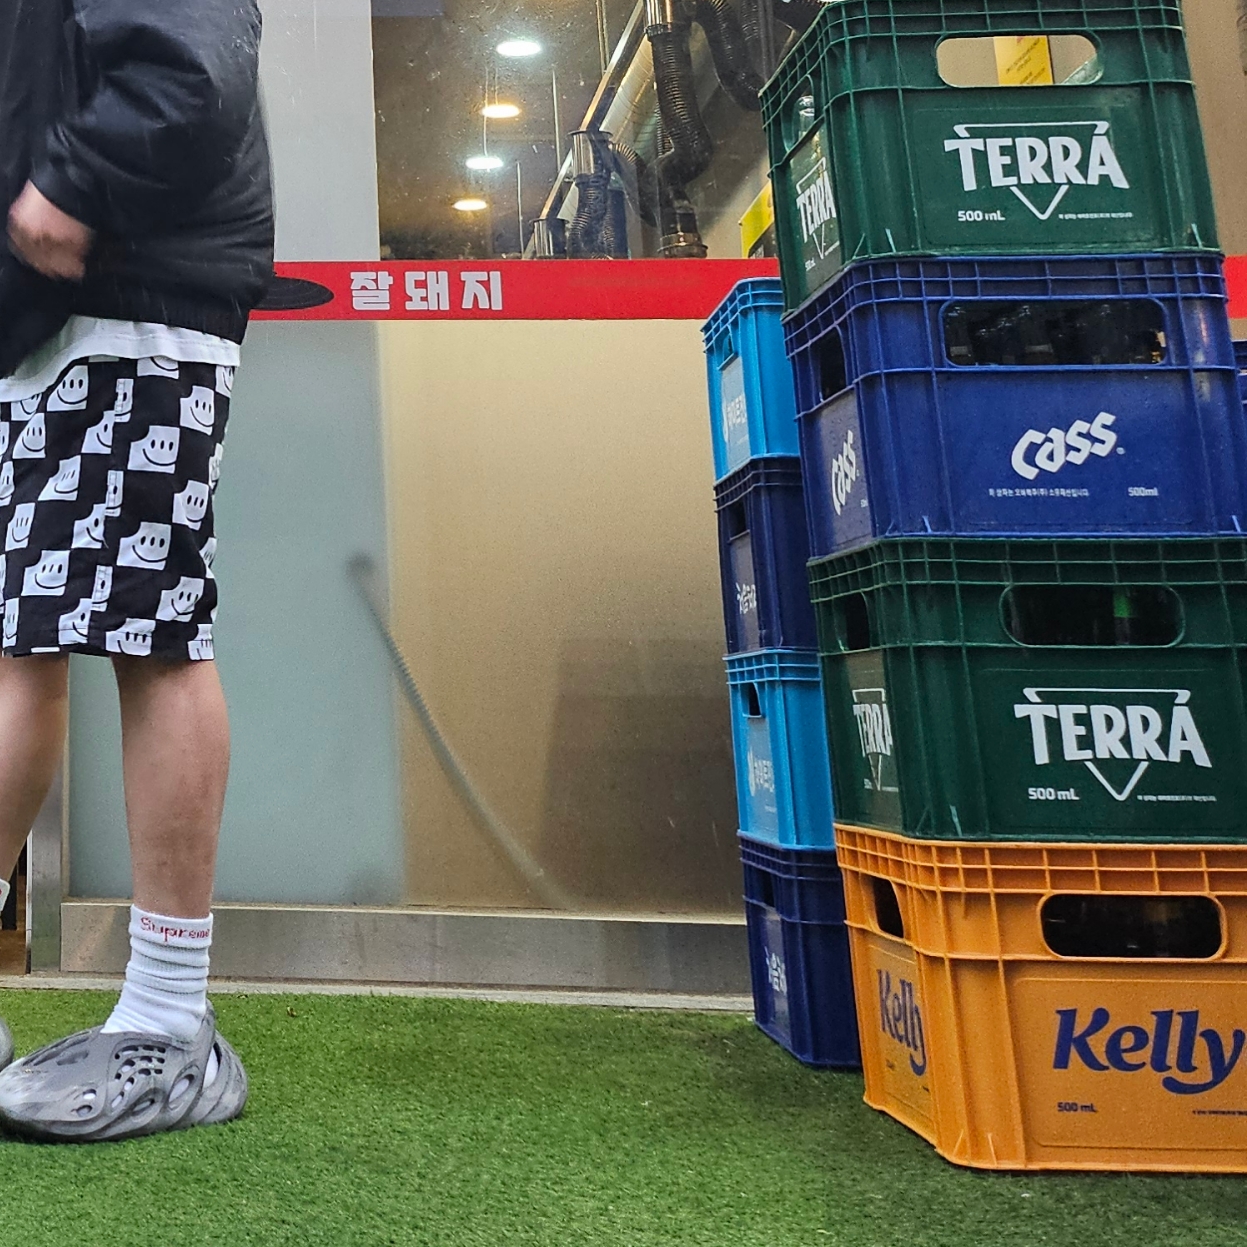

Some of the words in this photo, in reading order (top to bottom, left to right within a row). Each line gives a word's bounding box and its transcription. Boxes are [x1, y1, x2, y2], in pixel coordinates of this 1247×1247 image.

[944, 131, 1130, 192] TERRA
[796, 170, 837, 244] TERRA
[852, 703, 894, 758] TERRA
[1014, 696, 1212, 768] TERRA
[876, 968, 927, 1077] Kelly
[1053, 1006, 1247, 1095] Kelly
